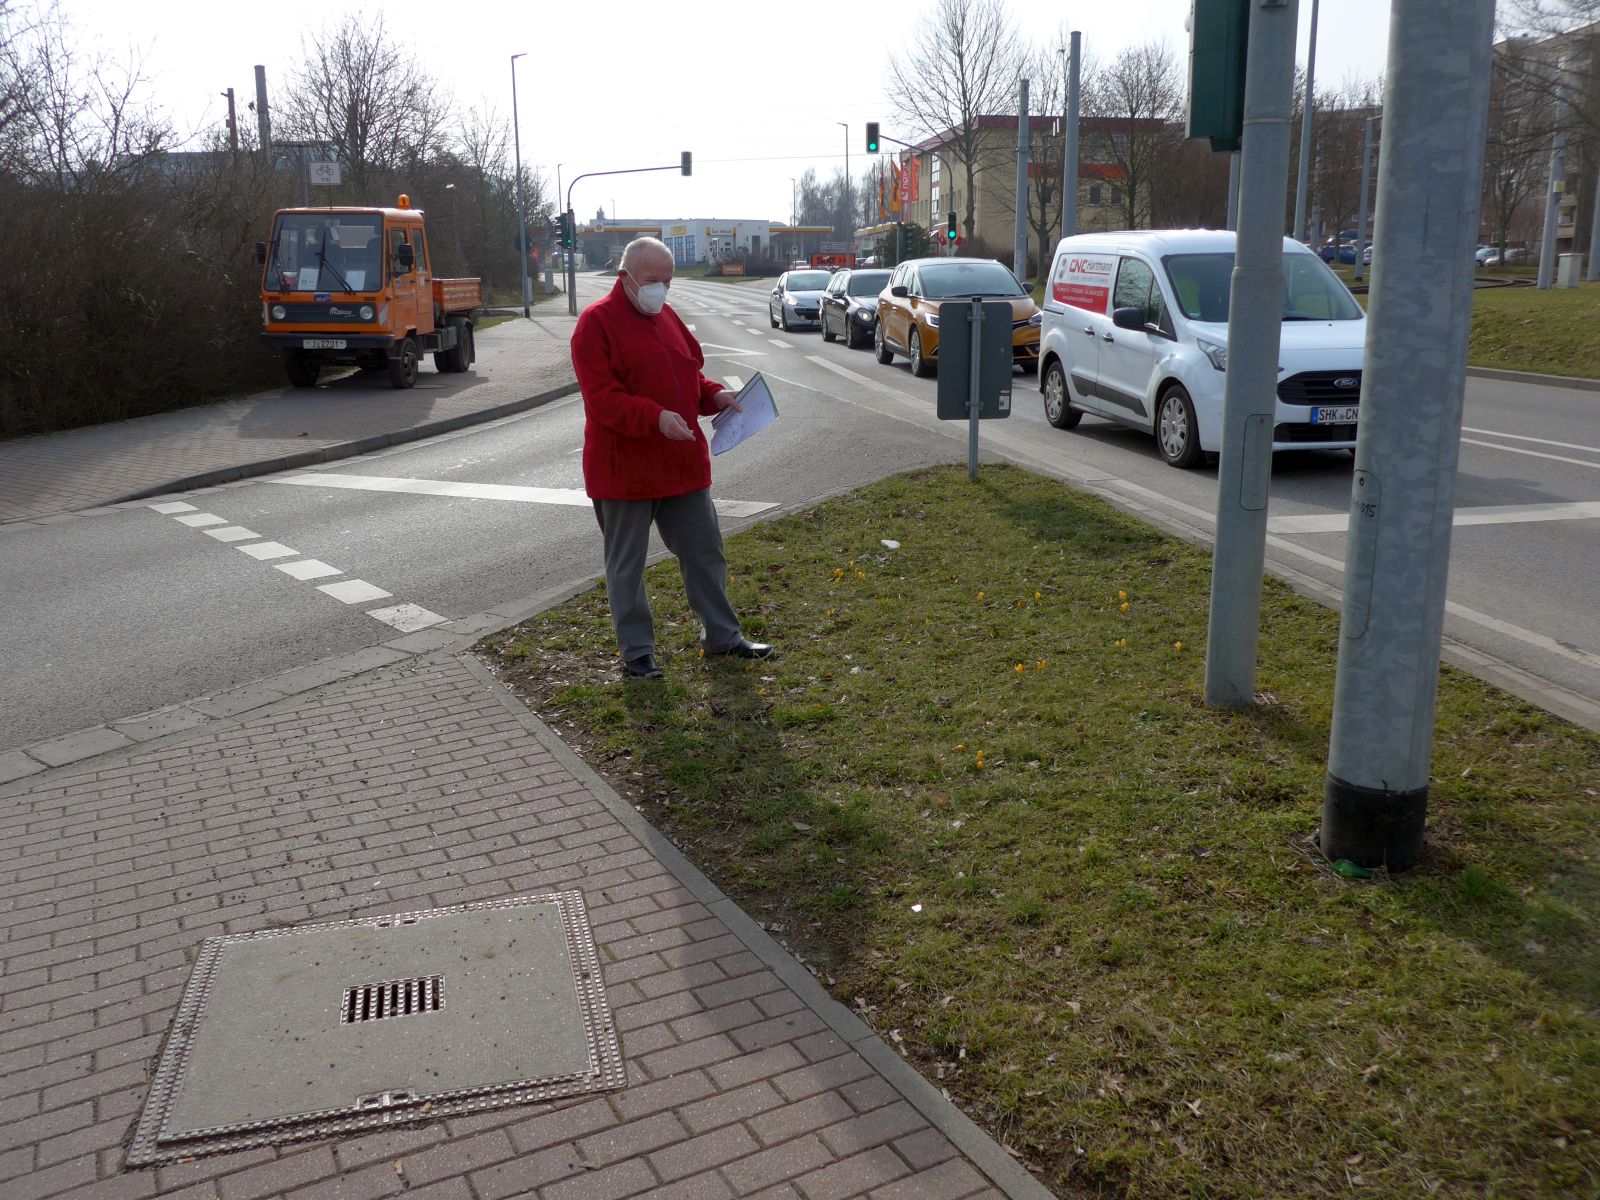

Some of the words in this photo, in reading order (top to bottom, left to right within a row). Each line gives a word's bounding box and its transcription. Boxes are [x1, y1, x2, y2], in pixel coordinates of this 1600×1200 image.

[1069, 259, 1088, 273] CNC
[1087, 260, 1113, 272] Hartmann
[1319, 408, 1338, 420] SHK
